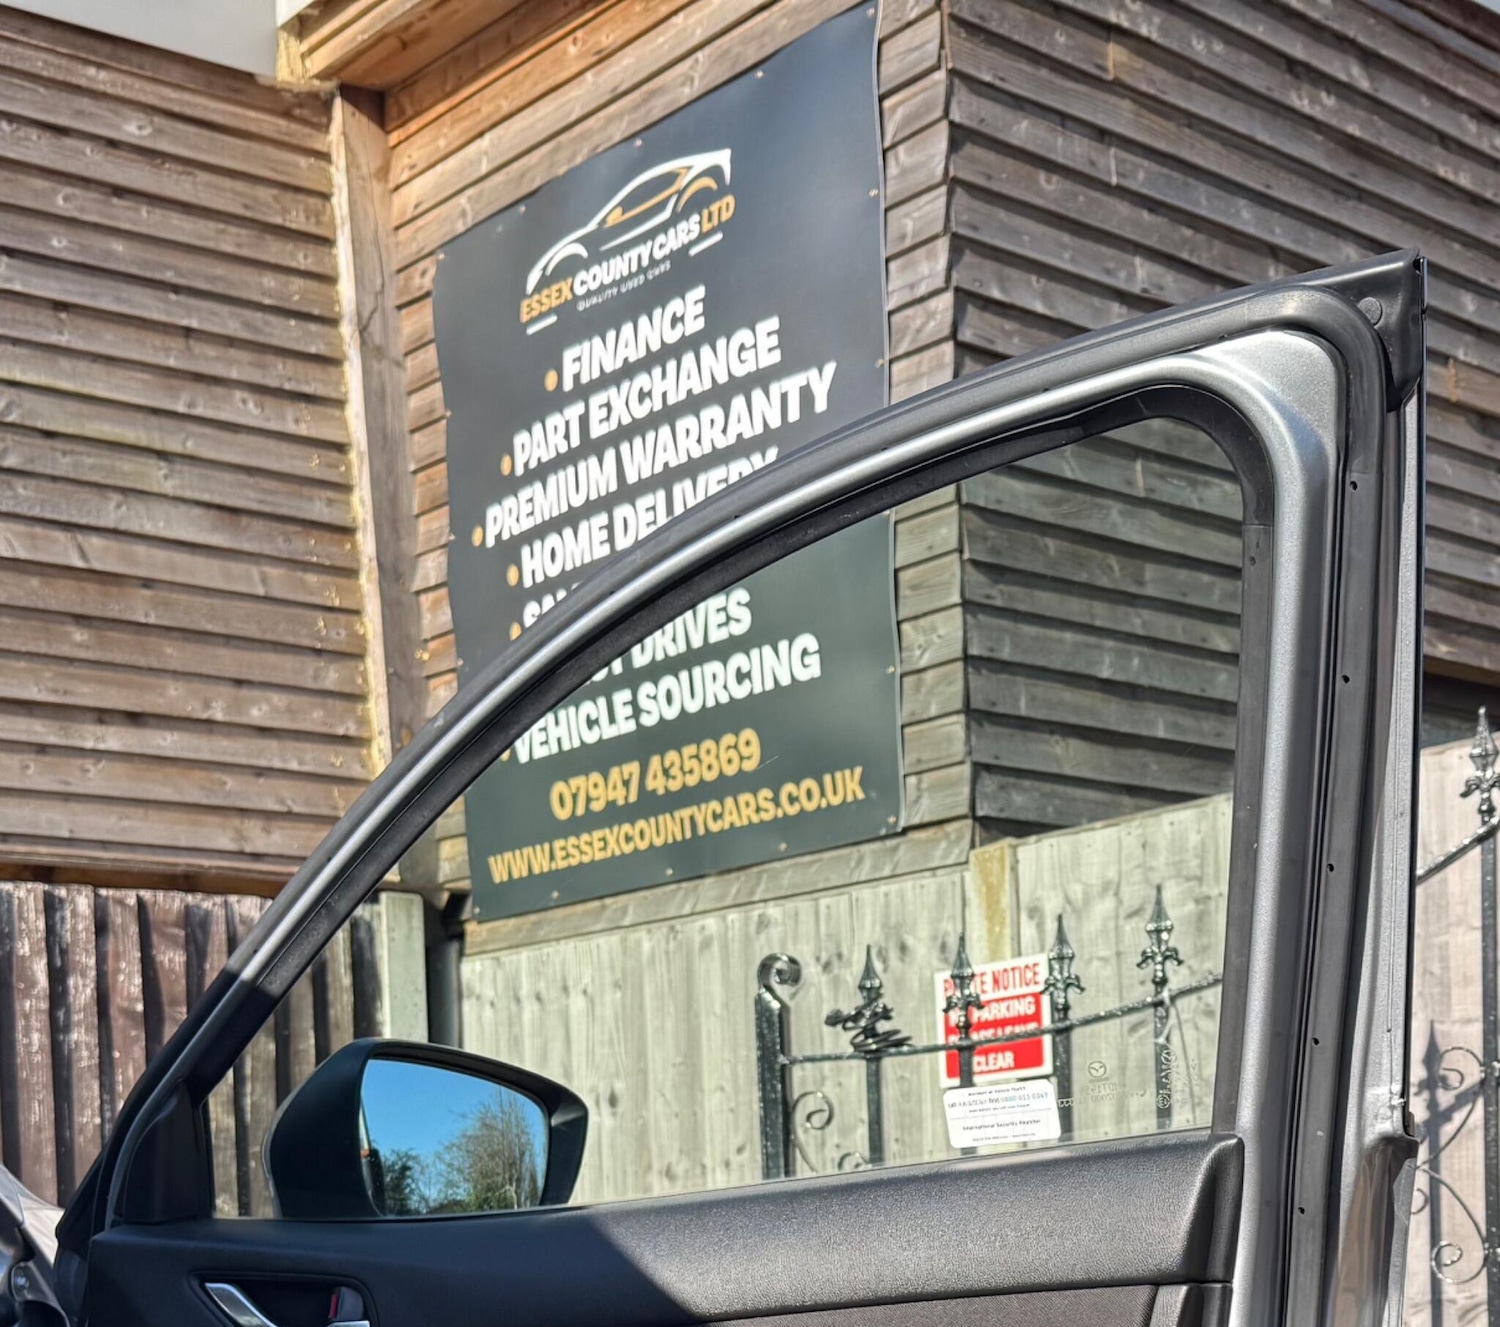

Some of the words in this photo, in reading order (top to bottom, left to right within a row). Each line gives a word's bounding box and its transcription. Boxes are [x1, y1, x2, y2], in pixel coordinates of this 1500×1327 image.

[520, 276, 574, 323] ESSEX
[573, 239, 653, 296] COUNTY
[652, 212, 701, 260] CARS
[701, 194, 736, 233] LTD
[576, 286, 619, 312] QUALITY
[620, 274, 645, 293] USED
[646, 259, 672, 280] CARS
[561, 285, 706, 392] FINANCE
[512, 400, 585, 477] PART
[589, 315, 782, 440] EXCHANGE
[484, 446, 618, 548] PREMIUM
[619, 360, 837, 485] WARRANTY
[520, 511, 611, 588] HOME
[513, 688, 637, 764] VEHICLE
[637, 632, 822, 727] SOURCING
[550, 760, 641, 821] 07947
[645, 727, 762, 796] 435869
[487, 765, 866, 884] WWW.ESSEXCOUNTYCARS.CO.UK
[972, 996, 1036, 1024] PARKING
[992, 962, 1040, 993] NOTICE
[973, 1051, 1015, 1072] CLEAR
